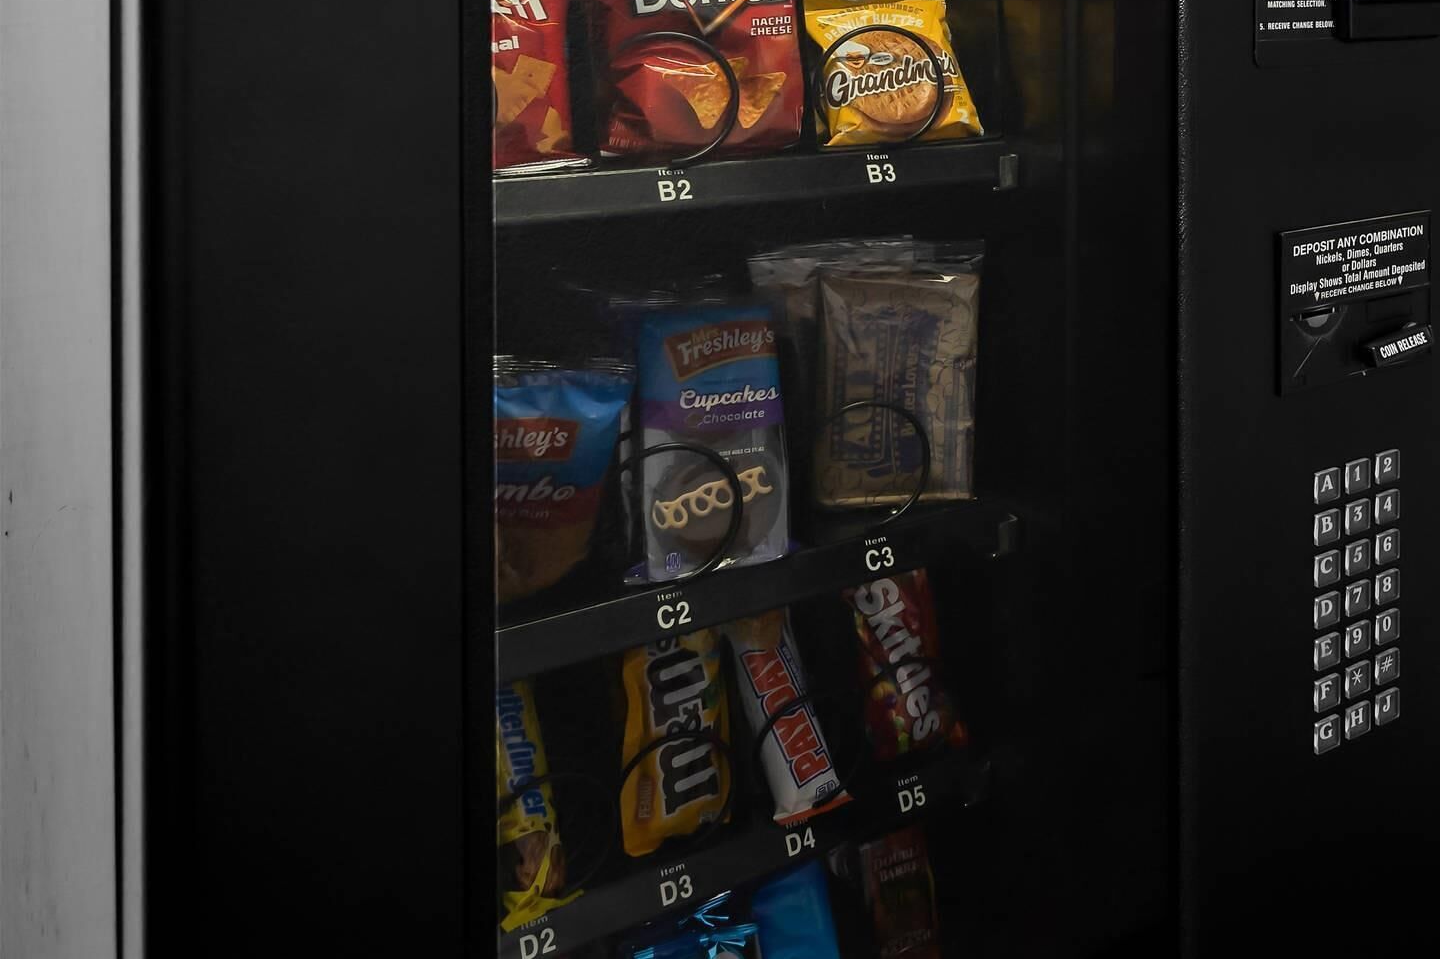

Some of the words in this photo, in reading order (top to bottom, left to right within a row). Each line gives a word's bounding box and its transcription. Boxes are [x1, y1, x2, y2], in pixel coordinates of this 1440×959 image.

[1268, 0, 1295, 9] MATCHING
[1297, 0, 1326, 8] SELECTION.
[751, 16, 792, 27] NACHO
[751, 25, 793, 37] CHEESE
[1268, 22, 1290, 30] RECEIVE
[1292, 21, 1314, 29] CHANGE
[1316, 20, 1335, 28] BELOW.
[866, 153, 889, 161] Item
[658, 168, 685, 177] Item
[866, 163, 896, 184] B3
[657, 180, 693, 202] B2
[1293, 240, 1335, 257] DEPOSIT
[1337, 236, 1358, 249] ANY
[1360, 225, 1423, 245] COMBINATION
[1316, 253, 1345, 265] Nickels,
[1347, 247, 1372, 259] Dimes,
[1374, 242, 1404, 254] Quarters
[1290, 281, 1318, 295] Display
[1319, 276, 1342, 289] Shows
[1344, 271, 1361, 283] Total
[1363, 268, 1389, 281] Amount
[1392, 260, 1426, 276] Deposited
[1342, 264, 1350, 272] or
[1351, 259, 1377, 270] Dollars
[1321, 288, 1346, 299] RECEIVE
[1348, 282, 1374, 294] CHANGE
[1375, 278, 1397, 289] BELOW
[677, 327, 775, 367] Freshley's
[1380, 342, 1399, 358] COIN
[1399, 332, 1427, 352] RELEASE
[679, 385, 780, 410] Cupcakes
[703, 409, 766, 426] Chocolate
[1321, 475, 1334, 492] A
[1355, 467, 1361, 481] 1
[1383, 458, 1392, 472] 2
[1321, 517, 1333, 534] B
[1354, 506, 1363, 522] 3
[1383, 497, 1392, 513] 4
[865, 535, 886, 546] Item
[865, 546, 895, 572] C3
[1321, 557, 1333, 574] C
[1353, 547, 1363, 562] 5
[1383, 537, 1392, 552] 6
[657, 590, 683, 603] Item
[1321, 600, 1333, 617] D
[1353, 588, 1362, 604] 7
[1383, 577, 1392, 592] 8
[656, 601, 692, 630] C2
[1321, 640, 1333, 657] E
[1353, 629, 1362, 645] 9
[1383, 616, 1391, 631] 0
[1321, 681, 1332, 700] F
[741, 650, 833, 788] PAYDAY
[1319, 723, 1333, 740] G
[1351, 708, 1364, 728] H
[1383, 696, 1391, 711] J
[897, 774, 919, 787] Item
[897, 786, 926, 813] D5
[785, 827, 816, 857] D4
[660, 861, 686, 877] Item
[660, 874, 693, 907] D3
[519, 927, 557, 959] D2
